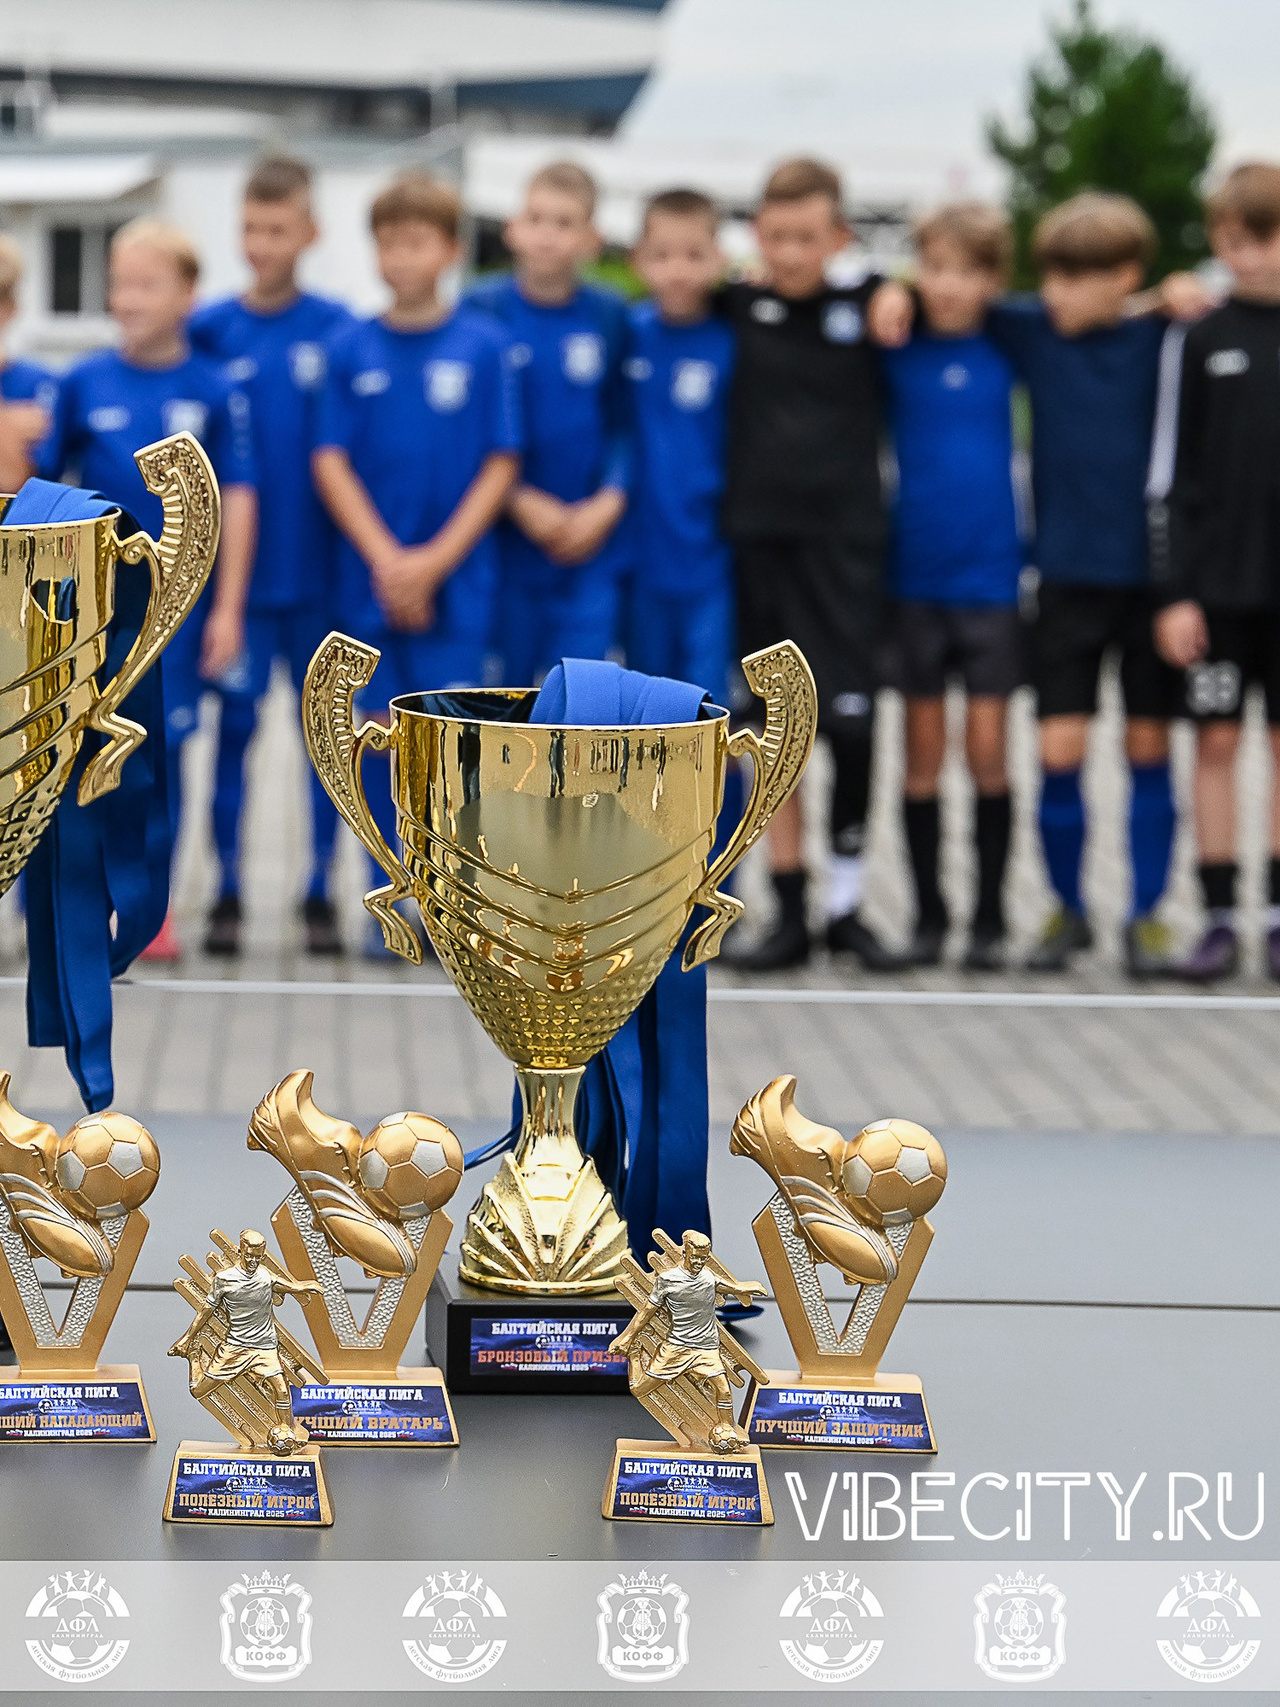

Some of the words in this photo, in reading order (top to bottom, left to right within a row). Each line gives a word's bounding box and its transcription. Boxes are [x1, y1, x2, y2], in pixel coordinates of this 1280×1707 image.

[492, 1321, 580, 1335] БАЛТИЙСКАЯ
[582, 1323, 618, 1335] ЛИГА
[478, 1348, 569, 1363] БРОНЗОВЫЙ
[84, 1387, 119, 1398] ЛИГА
[301, 1387, 386, 1400] БАЛТИЙСКАЯ
[388, 1388, 423, 1400] ЛИГА
[778, 1392, 864, 1406] БАЛТИЙСКАЯ
[867, 1394, 902, 1408] ЛИГА
[40, 1412, 142, 1428] НАПАДАЮЩИЙ
[294, 1415, 364, 1430] УЧШИЙ
[368, 1417, 444, 1430] ВРАТАРЬ
[755, 1419, 827, 1434] ЛУЧШИЙ
[831, 1422, 924, 1438] ЗАЩИТНИК
[183, 1462, 272, 1477] БАЛТИЙСКАЯ
[275, 1465, 312, 1478] ЛИГА
[624, 1461, 714, 1476] БАЛТИЙСКАЯ
[716, 1465, 753, 1478] ЛИГА
[179, 1492, 263, 1508] ПОЛЕЗНЫЙ
[266, 1496, 315, 1509] ИГРОК
[620, 1492, 704, 1508] ПОЛЕЗНЫЙ
[708, 1496, 756, 1510] ИГРОК
[208, 1508, 264, 1518] КАЛИНИНГРАД
[266, 1510, 285, 1518] 2025
[648, 1508, 706, 1518] КАЛИНИНГРАД
[706, 1510, 726, 1518] 2025
